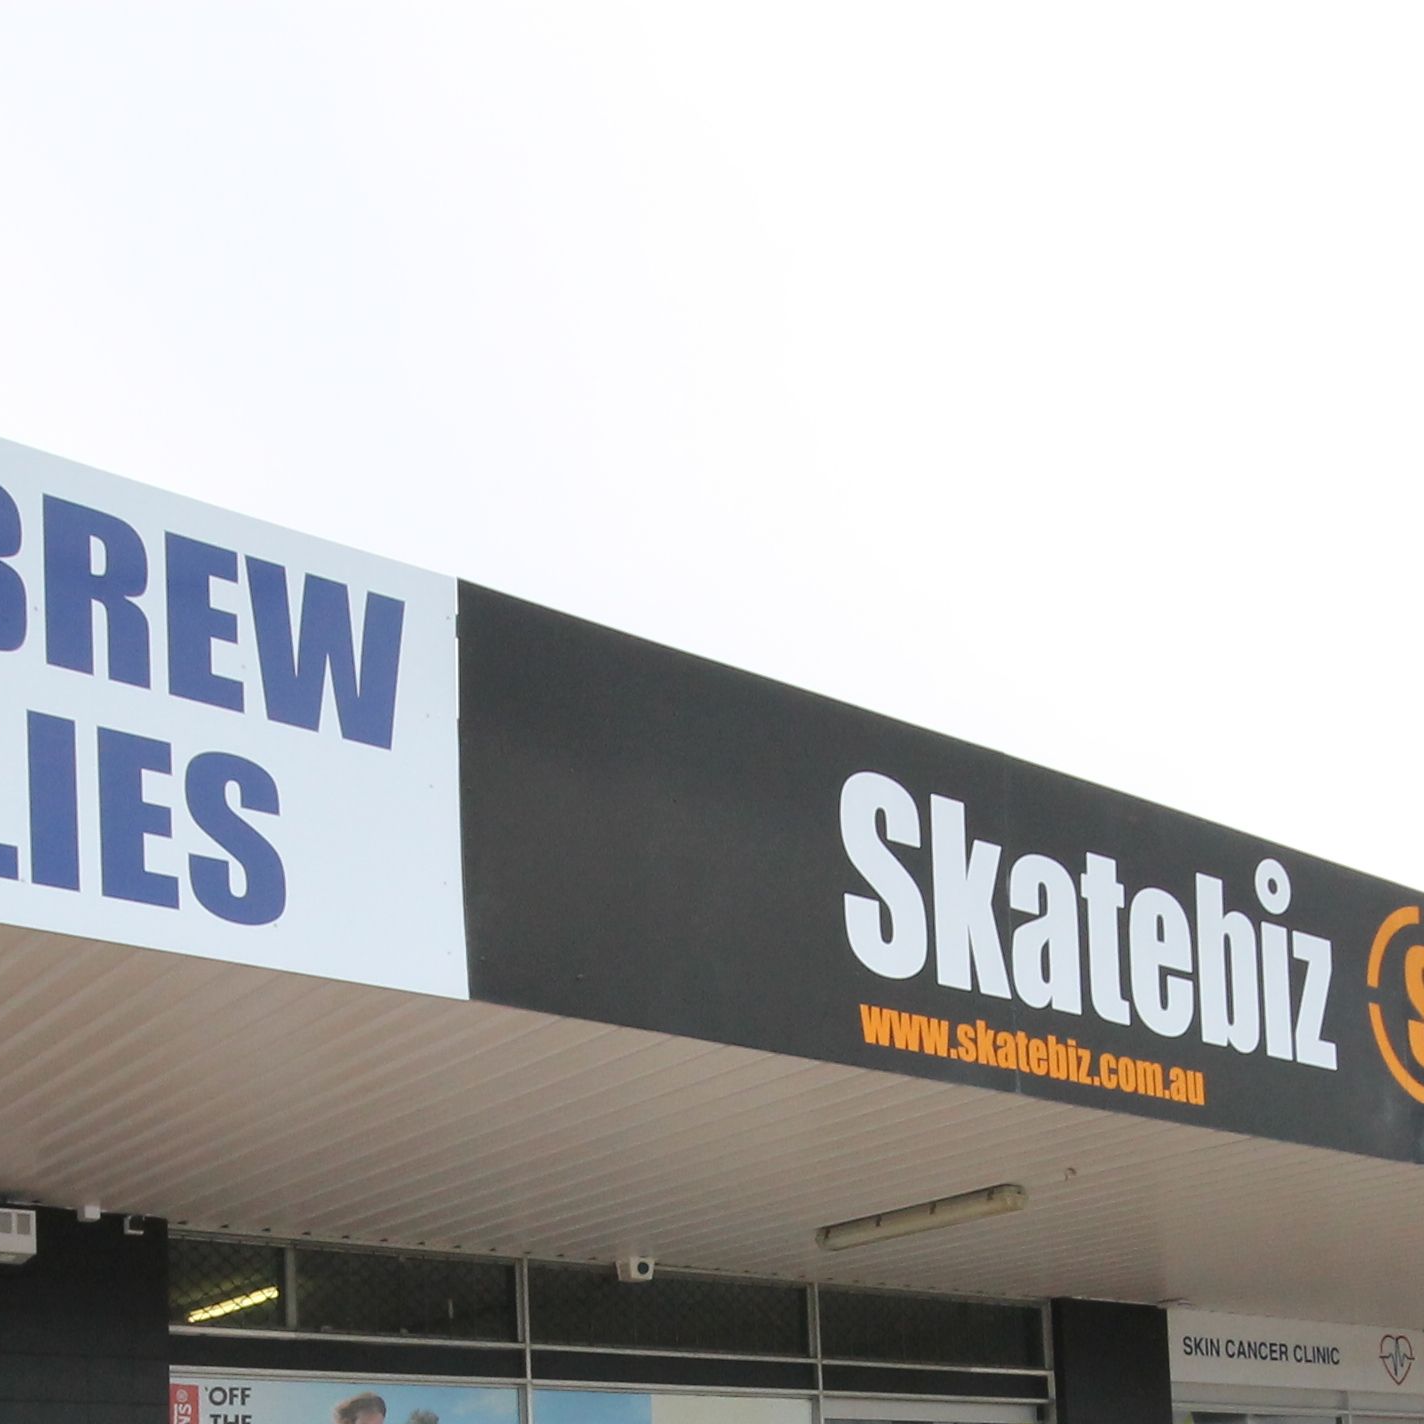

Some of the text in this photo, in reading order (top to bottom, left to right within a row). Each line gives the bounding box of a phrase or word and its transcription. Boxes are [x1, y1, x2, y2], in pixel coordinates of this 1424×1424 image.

[839, 771, 1339, 1070] Skatebiz
[859, 1004, 1206, 1107] www.skatebiz.com.au
[1182, 1335, 1341, 1365] SKIN CANCER CLINIC
